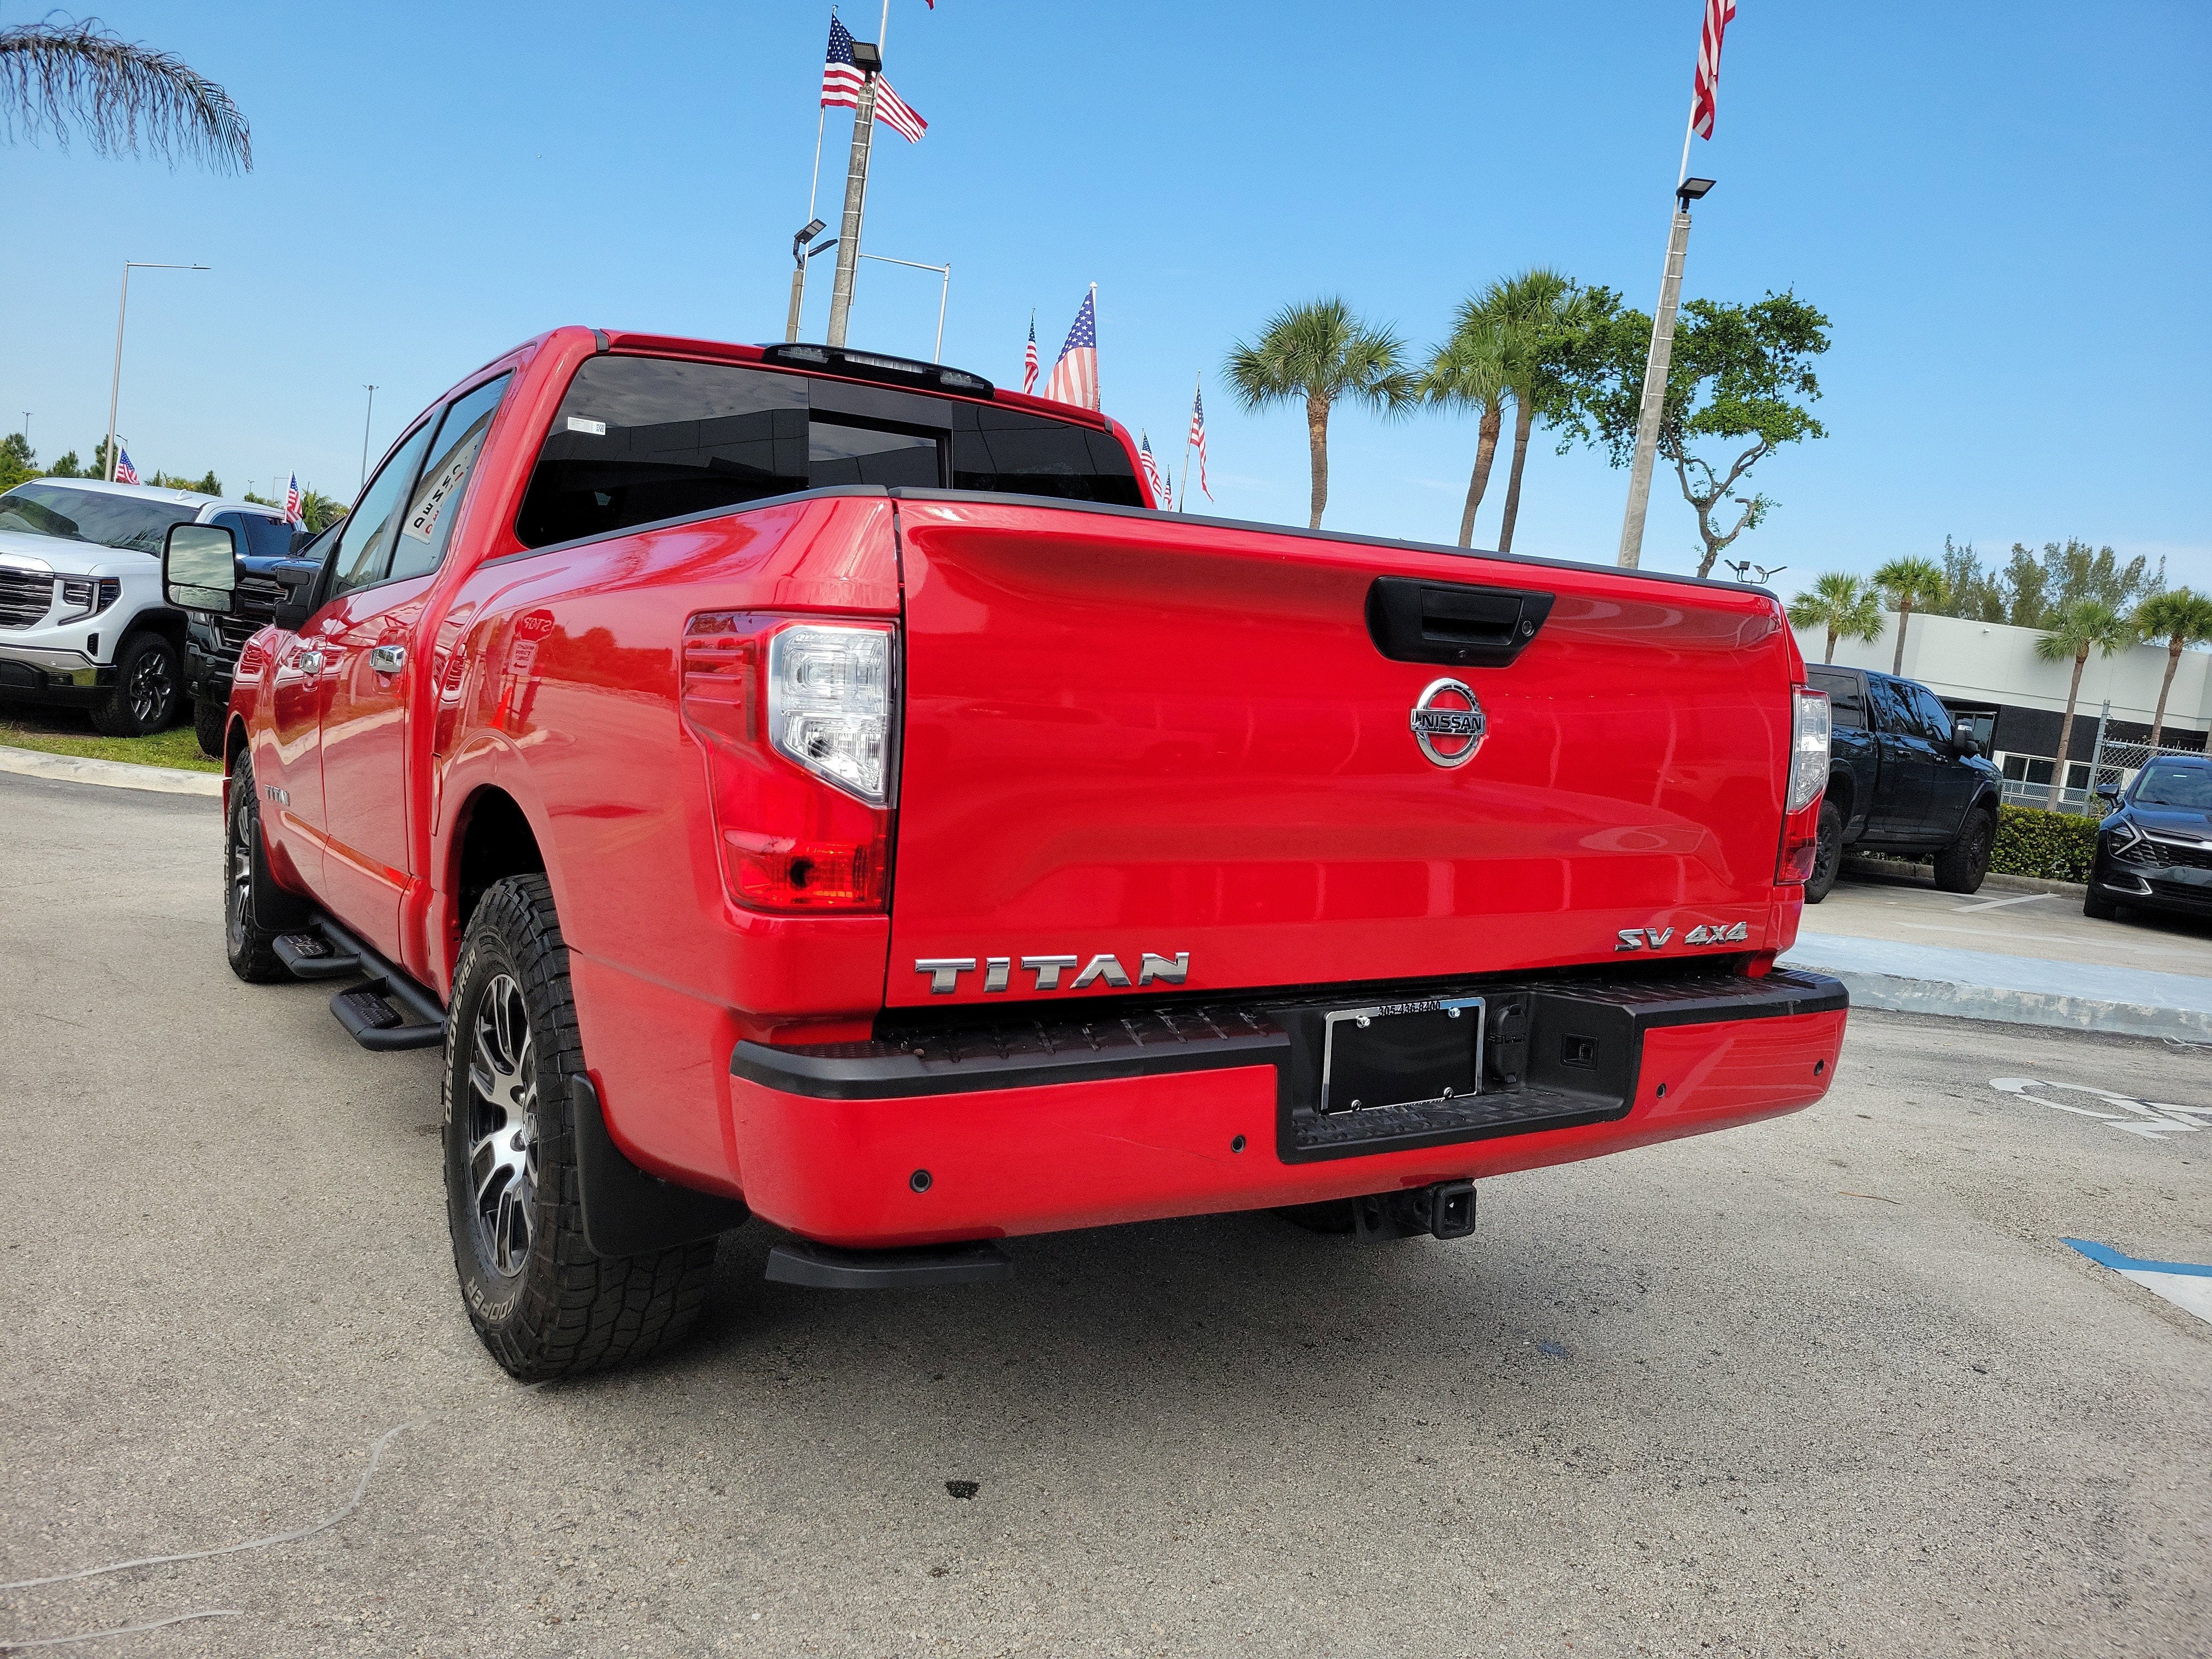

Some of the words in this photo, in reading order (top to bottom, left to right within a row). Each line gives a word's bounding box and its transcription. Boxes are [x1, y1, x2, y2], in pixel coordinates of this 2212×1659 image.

[1421, 714, 1482, 731] NISSAN
[1615, 927, 1675, 952] SV
[915, 952, 1190, 994] TITAN
[445, 946, 477, 1125] DISCOVERER
[467, 1276, 516, 1321] COOPER
